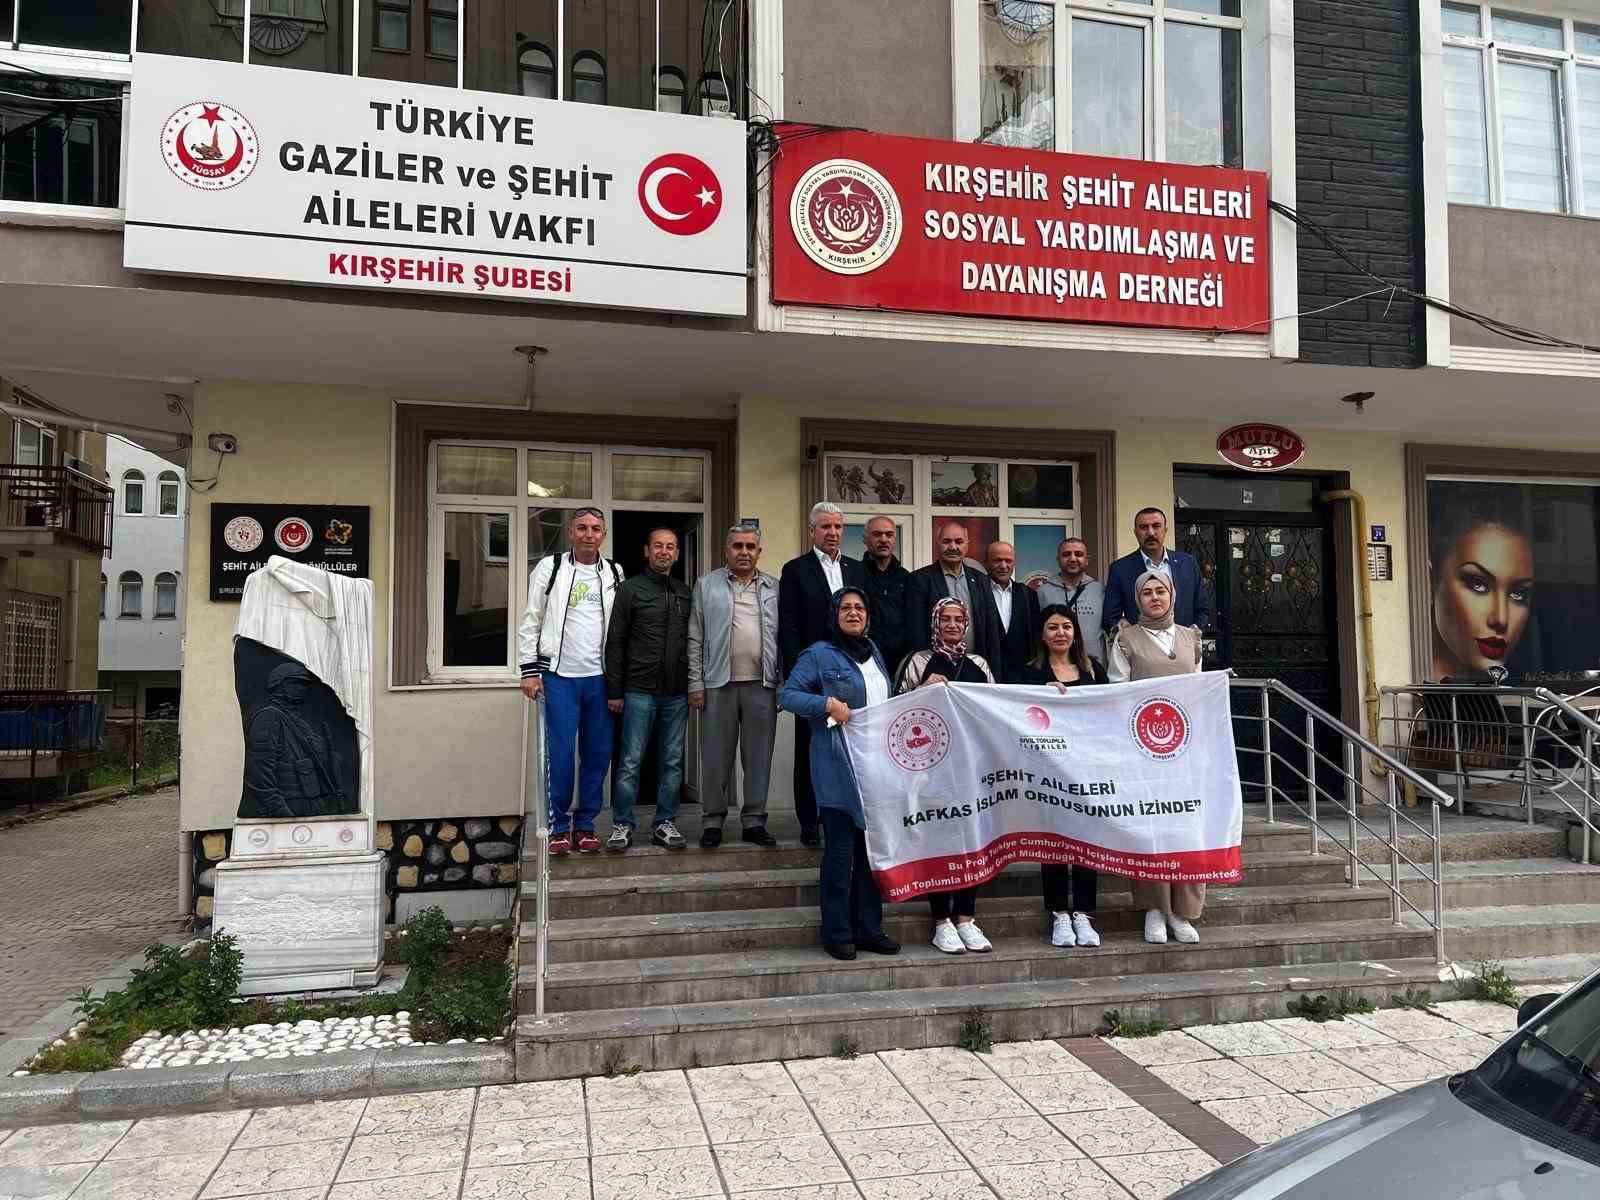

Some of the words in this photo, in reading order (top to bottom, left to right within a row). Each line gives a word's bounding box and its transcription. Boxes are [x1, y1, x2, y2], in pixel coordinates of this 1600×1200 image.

[369, 99, 534, 146] TÜRKİYE
[279, 141, 445, 185] GAZİLER
[456, 166, 496, 189] ve
[508, 164, 613, 201] ŞEHİT
[925, 162, 1049, 202] KIRŞEHİR
[1062, 172, 1136, 210] ŞEHİT
[1144, 177, 1252, 219] AİLELERİ
[303, 189, 475, 237] AİLELERİ
[488, 210, 595, 246] VAKFI
[924, 209, 1026, 246] SOSYAL
[1035, 219, 1217, 264] YARDIMLAŞMA
[1223, 234, 1255, 264] VE
[329, 252, 464, 284] KIRŞEHİR
[473, 264, 572, 293] ŞUBESİ
[828, 253, 866, 265] KIRŞEHİR
[962, 261, 1108, 304] DAYANIŞMA
[1119, 272, 1224, 308] DERNEĞİ
[1251, 459, 1273, 468] 24
[222, 560, 248, 572] ŞEHİT
[902, 804, 973, 828] KAFKAS
[976, 788, 1018, 813] İSLAM
[1024, 789, 1135, 818] ORDUSUNUN
[1040, 777, 1116, 796] AİLELERİ
[889, 883, 910, 897] Sivil
[912, 875, 961, 891] Toplumla
[1019, 848, 1075, 862] Müdürlüğü
[1078, 855, 1135, 877] Tarafından
[948, 862, 963, 871] Bu
[989, 839, 1018, 858] Türkiye
[1019, 837, 1084, 854] Cumhuriyeti
[1127, 858, 1181, 870] Bakanlığı
